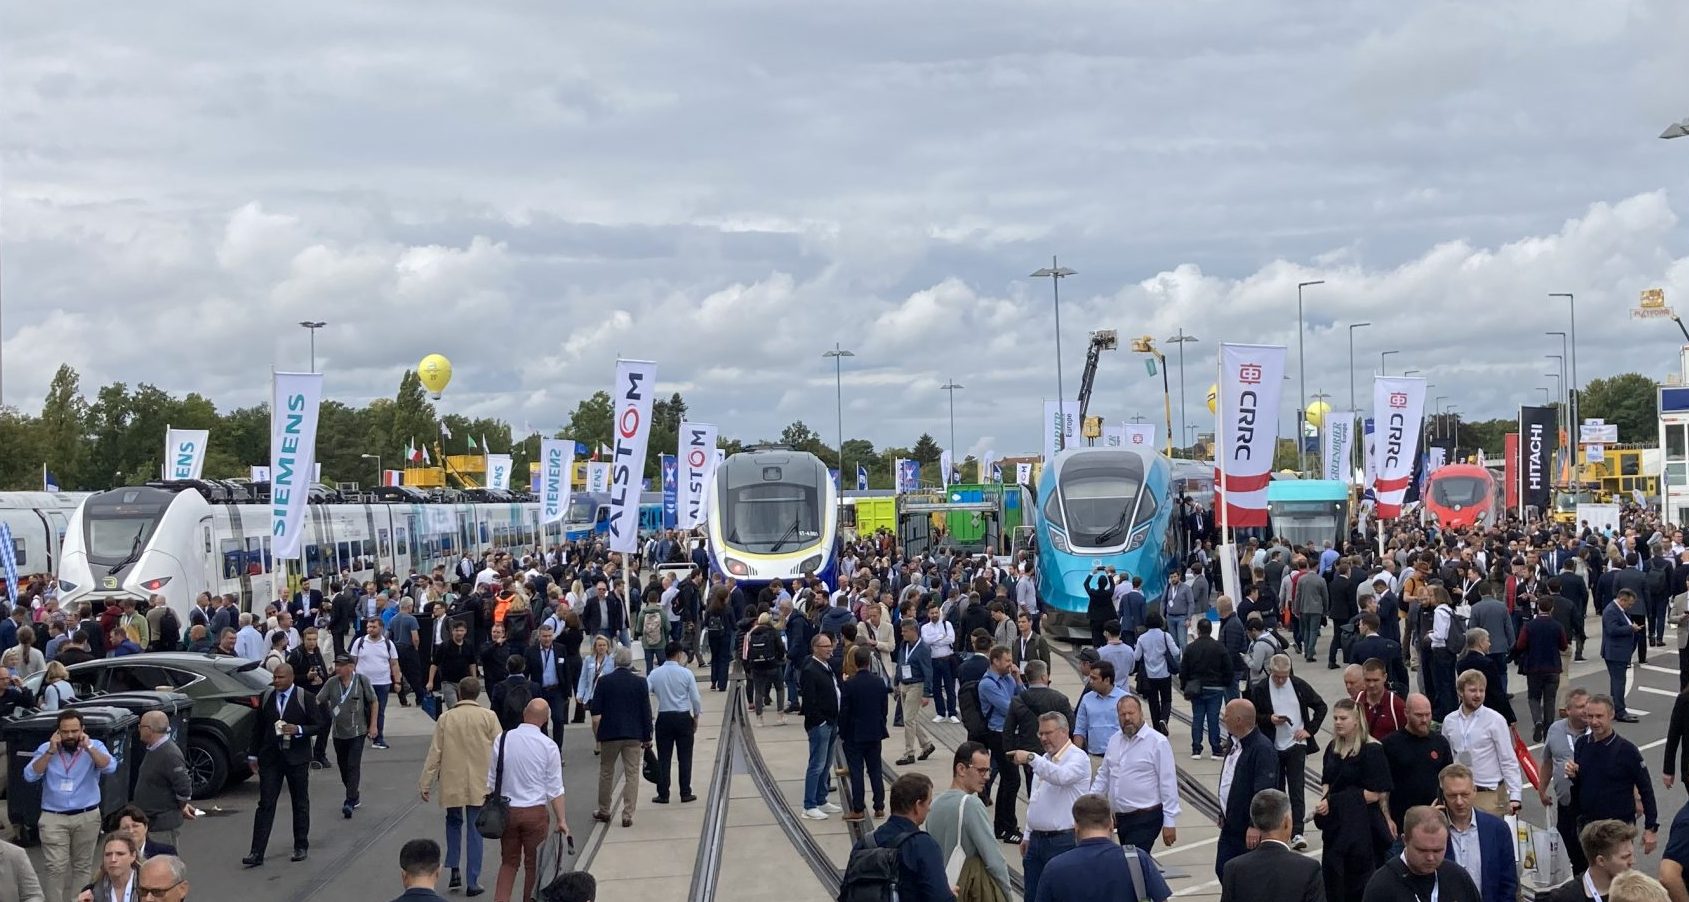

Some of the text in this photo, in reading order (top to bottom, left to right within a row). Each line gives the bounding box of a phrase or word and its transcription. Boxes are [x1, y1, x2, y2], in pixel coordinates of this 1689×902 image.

[610, 372, 643, 538] ALSTOM
[1235, 390, 1257, 460] CRRC
[1386, 413, 1403, 469] CRRC
[1530, 424, 1543, 490] HITACHI
[175, 441, 194, 478] ENS
[273, 393, 305, 537] SIEMENS
[492, 465, 504, 489] ENS
